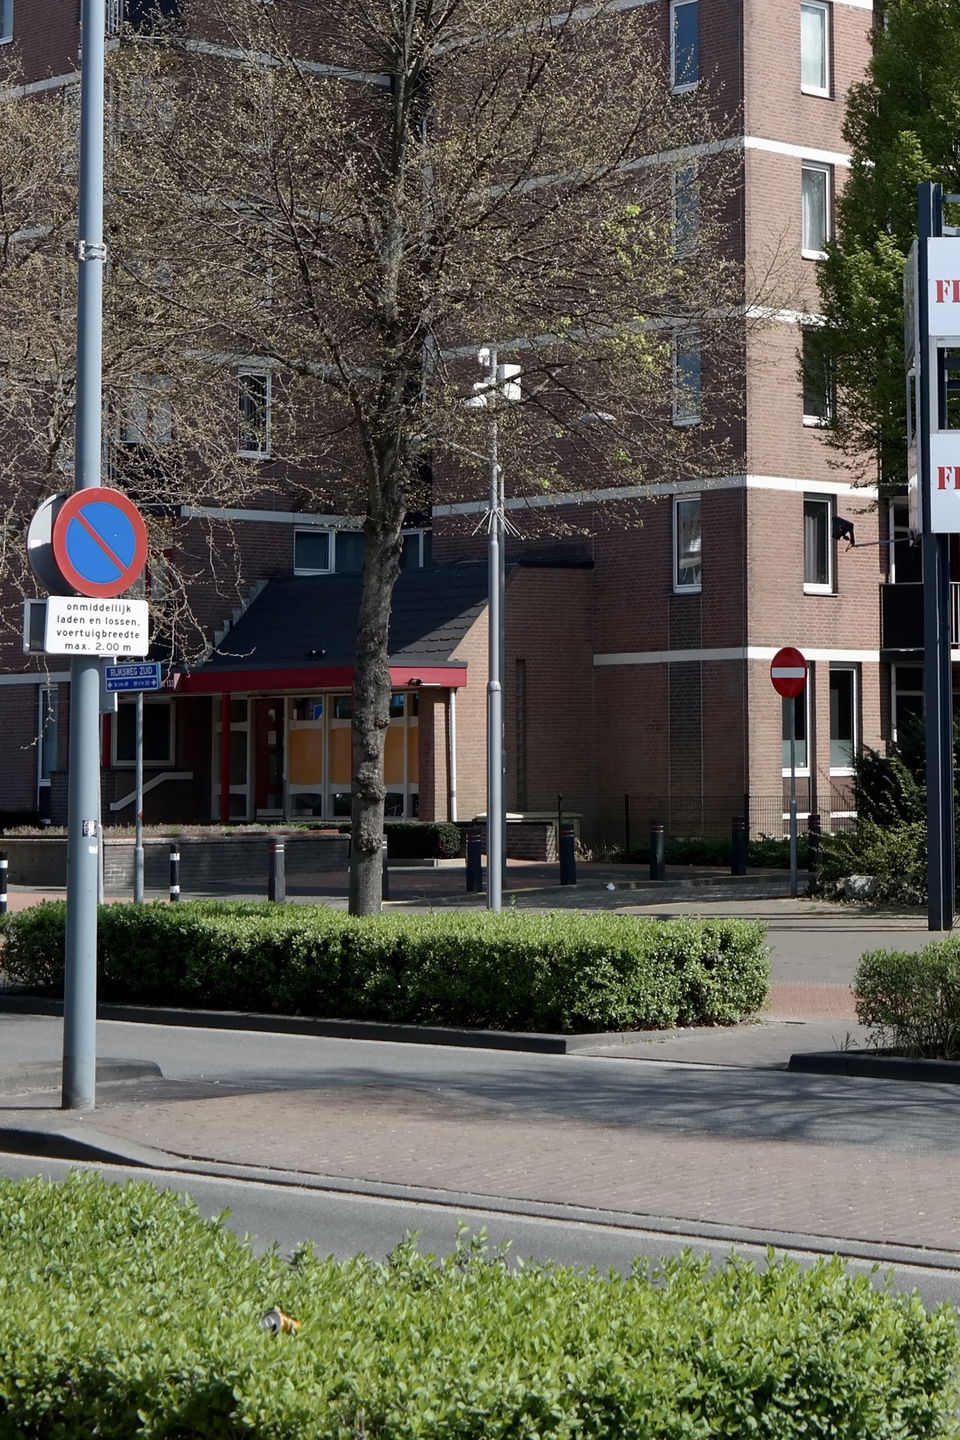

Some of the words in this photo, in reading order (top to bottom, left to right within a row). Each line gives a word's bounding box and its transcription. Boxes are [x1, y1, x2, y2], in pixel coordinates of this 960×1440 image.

[67, 604, 131, 615] onmiddellijk
[56, 615, 85, 624] laden
[89, 617, 101, 625] en
[57, 629, 140, 639] voertuigbreedte
[64, 643, 91, 651] max.
[122, 644, 132, 652] m
[110, 667, 138, 677] RIJKSWEG
